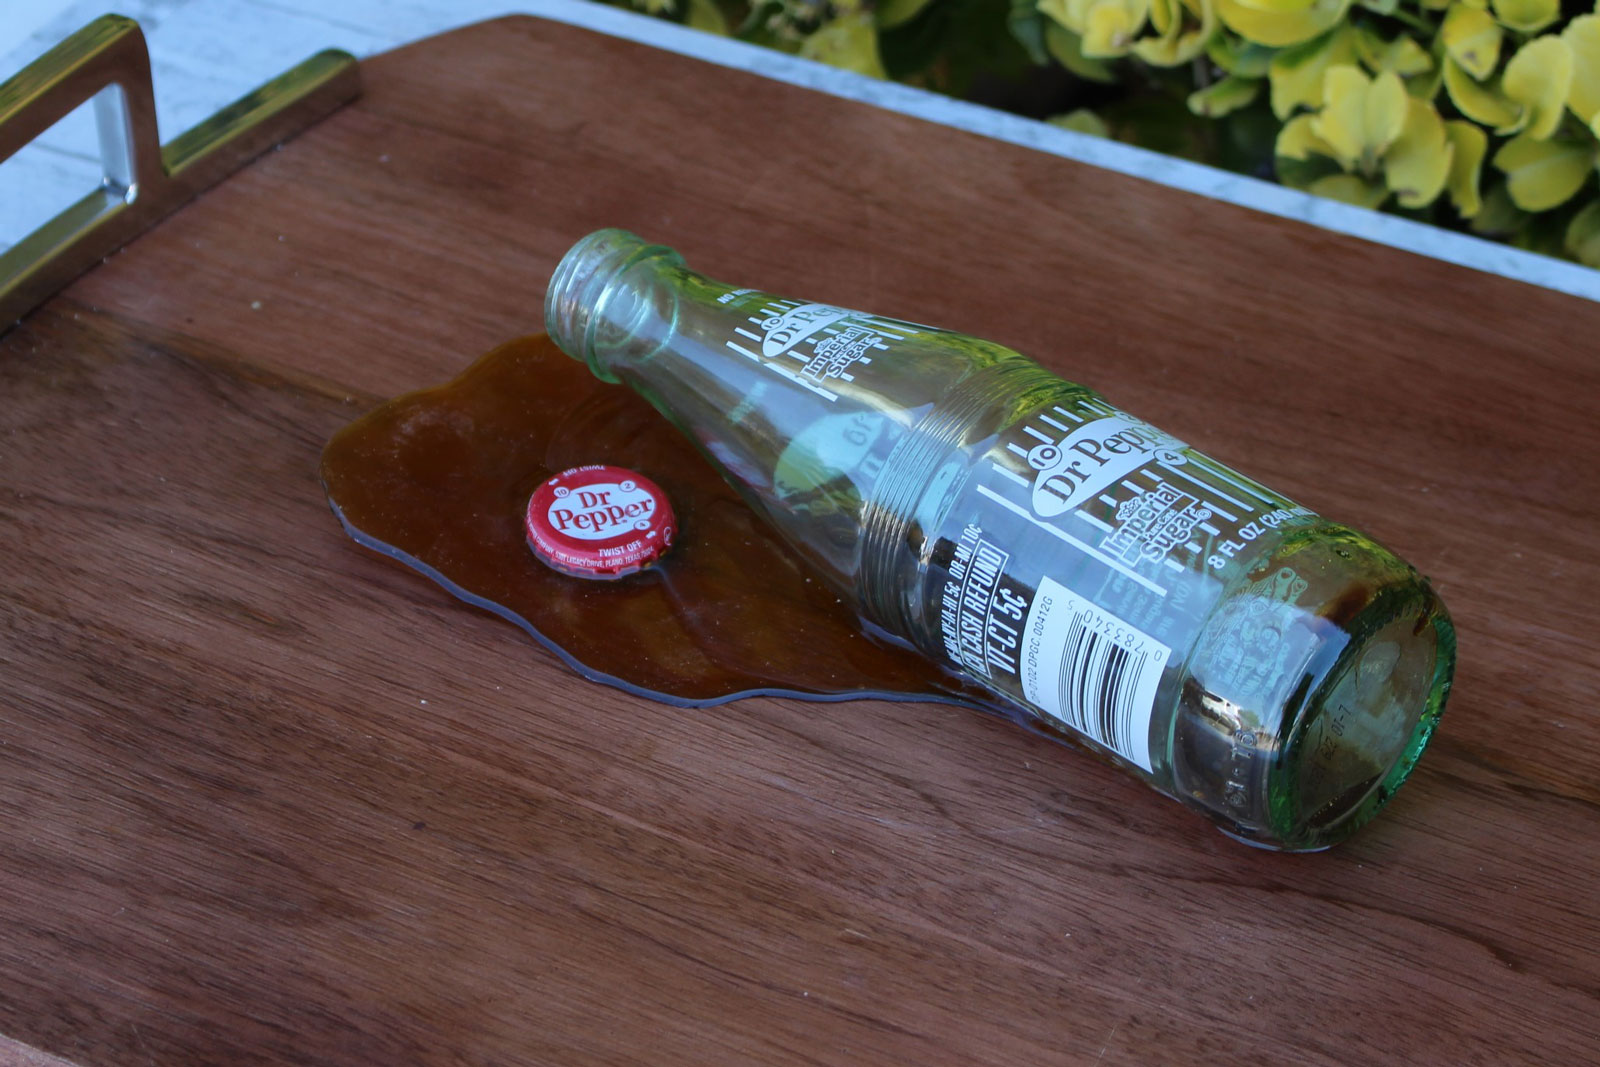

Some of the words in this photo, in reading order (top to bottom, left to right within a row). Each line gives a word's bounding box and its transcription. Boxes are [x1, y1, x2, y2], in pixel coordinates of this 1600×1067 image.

[763, 318, 781, 329] 10
[767, 323, 803, 346] Dr
[803, 328, 860, 375] Imperial
[827, 338, 872, 376] Sugar
[1032, 447, 1057, 467] 10
[1164, 452, 1180, 462] 4
[576, 491, 611, 509] Dr
[1038, 460, 1092, 504] Dr
[551, 498, 653, 533] Pepper
[1101, 483, 1182, 558] Imperial
[598, 546, 625, 557] TWIST
[626, 539, 643, 552] OFF
[961, 523, 983, 545] 10¢
[1141, 507, 1198, 562] Sugar
[1207, 555, 1226, 569] 8
[1218, 540, 1247, 558] FL
[1239, 522, 1267, 540] OZ
[1259, 509, 1294, 529] (240
[949, 543, 973, 580] OR-MI
[945, 581, 961, 598] 5¢
[964, 547, 1002, 616] REFUND
[992, 588, 1028, 621] 5¢
[961, 610, 985, 654] CASH
[987, 614, 1018, 675] VT-CT
[1027, 595, 1053, 667] DPGC.00412G
[1083, 609, 1144, 654] 783340
[963, 650, 987, 673] CA
[1153, 649, 1163, 662] 0
